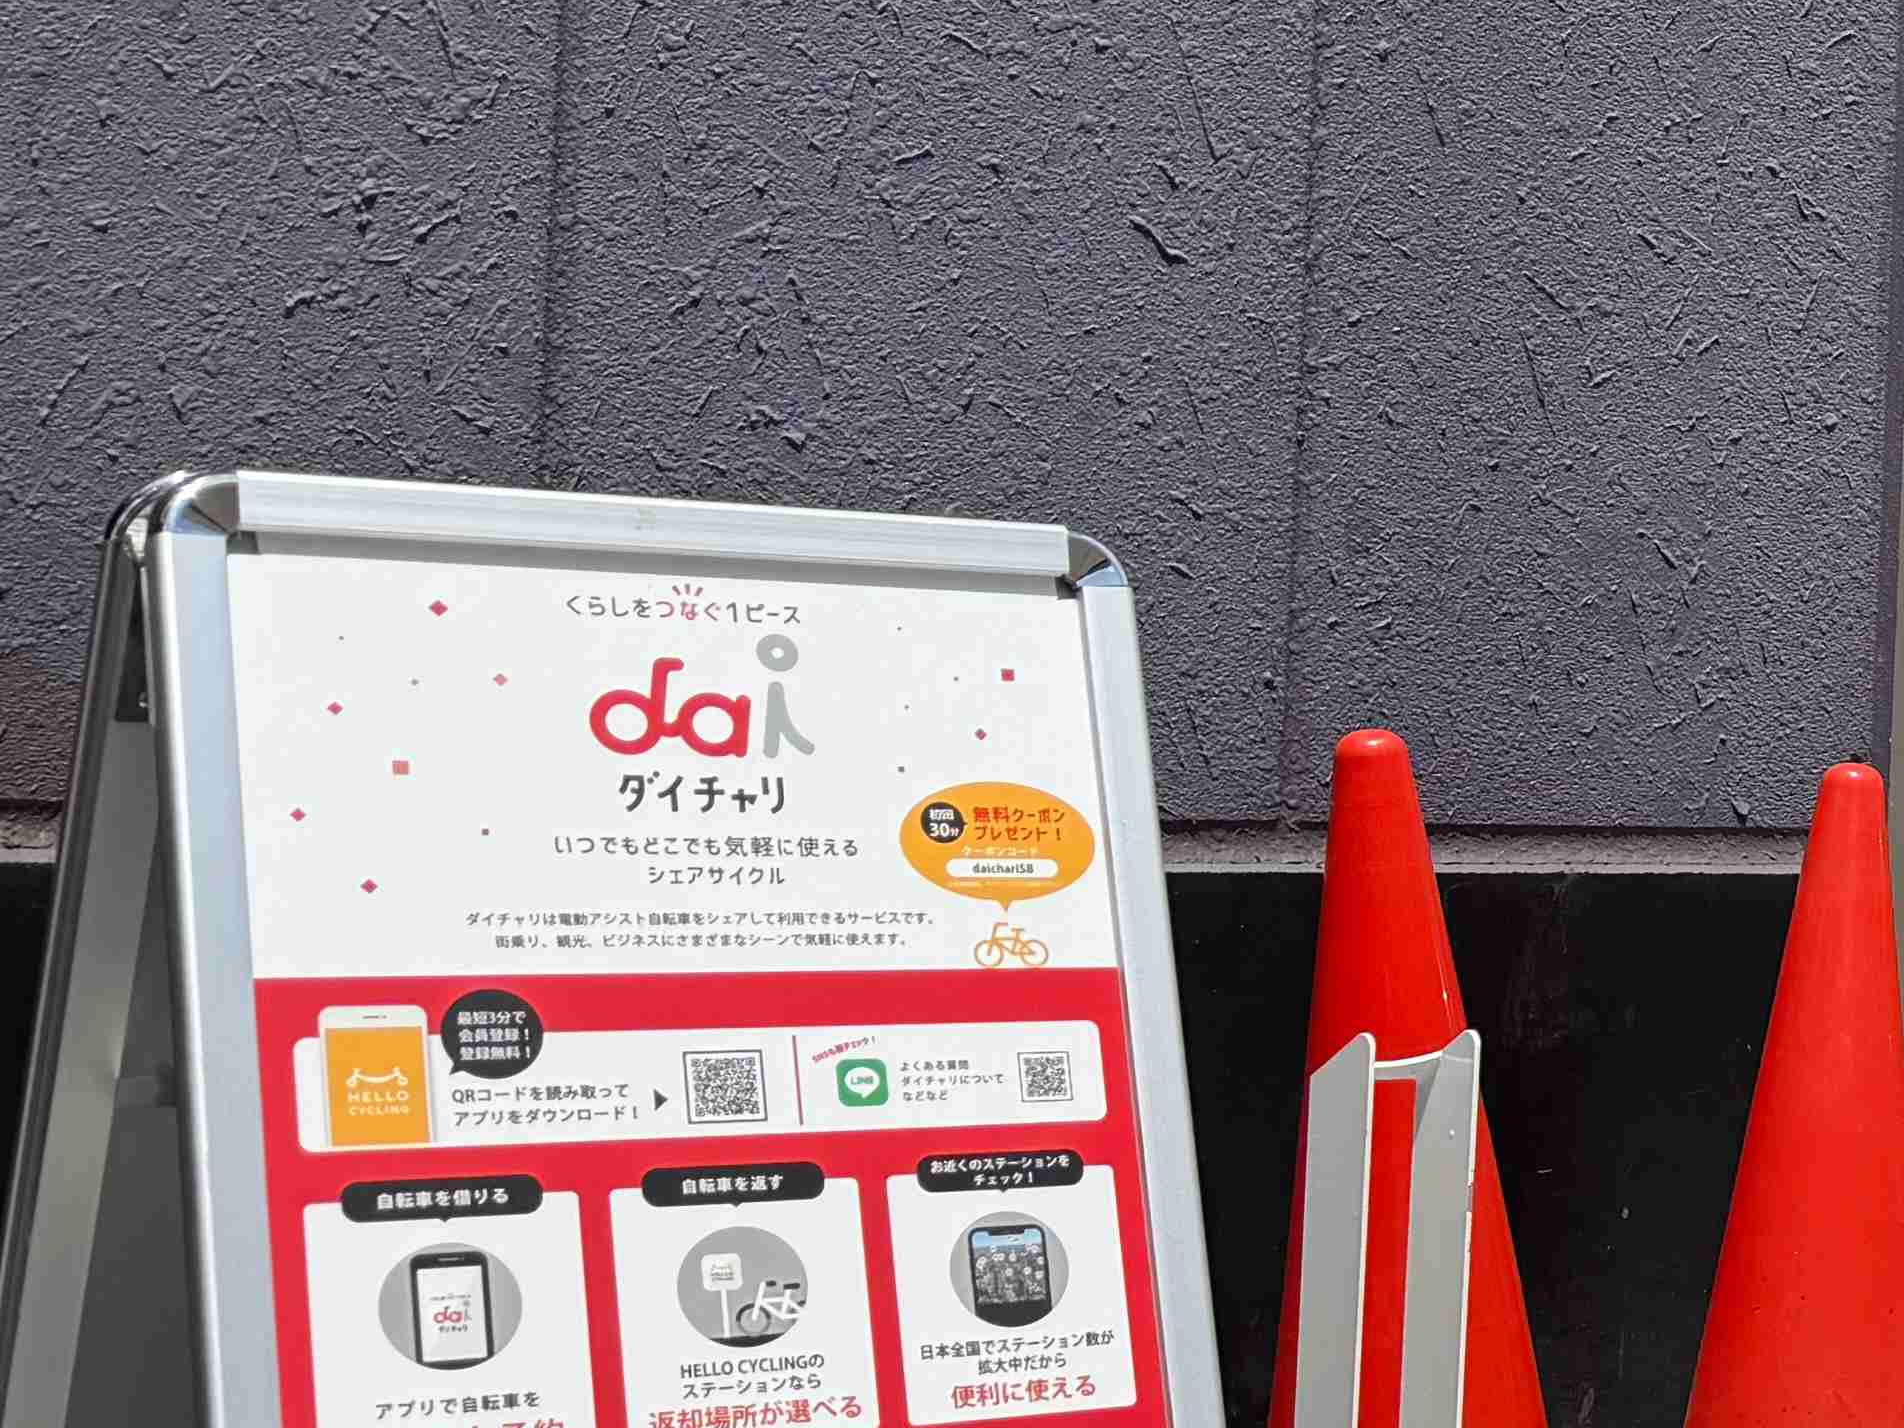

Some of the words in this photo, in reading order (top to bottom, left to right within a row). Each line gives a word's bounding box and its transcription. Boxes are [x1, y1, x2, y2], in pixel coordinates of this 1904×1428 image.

[589, 633, 815, 759] dai
[618, 770, 785, 814] ダイチャリ
[972, 806, 1065, 824] 無料クーポン
[974, 825, 1063, 841] プレゼント！
[553, 835, 860, 859] いつでもどこでも気軽に使える
[648, 865, 786, 887] シェアサイクル
[464, 911, 936, 928] ダイチャリは電動アシスト自転車をシェアして利用できるサービスです。
[456, 1010, 528, 1025] 最短3分で
[458, 1027, 531, 1044] 会員登録！
[459, 1045, 531, 1062] 登録無料！
[900, 1059, 969, 1073] よくある質問
[850, 1074, 874, 1085] LINE
[900, 1072, 1004, 1087] ダイチャリについて
[347, 1089, 409, 1102] HELLO
[451, 1083, 629, 1104] QRコードを読み取って
[902, 1090, 950, 1102] などなど
[348, 1104, 410, 1116] CYCLING
[455, 1106, 639, 1127] アプリをダウンロード！
[929, 1155, 1071, 1174] お近くのステーションを
[681, 1174, 783, 1195] 自転車を返す
[973, 1172, 1034, 1187] チェック！
[376, 1187, 510, 1211] 自転車を借りる
[920, 1330, 1115, 1361] 日本全国でステーション数が
[680, 1360, 734, 1379] HELLO
[737, 1353, 825, 1375] CYCLINGの
[978, 1352, 1067, 1375] 拡大中だから
[682, 1373, 822, 1400] ステーションなら
[951, 1374, 1097, 1410] 便利に使える
[375, 1391, 541, 1420] アプリで自転車を
